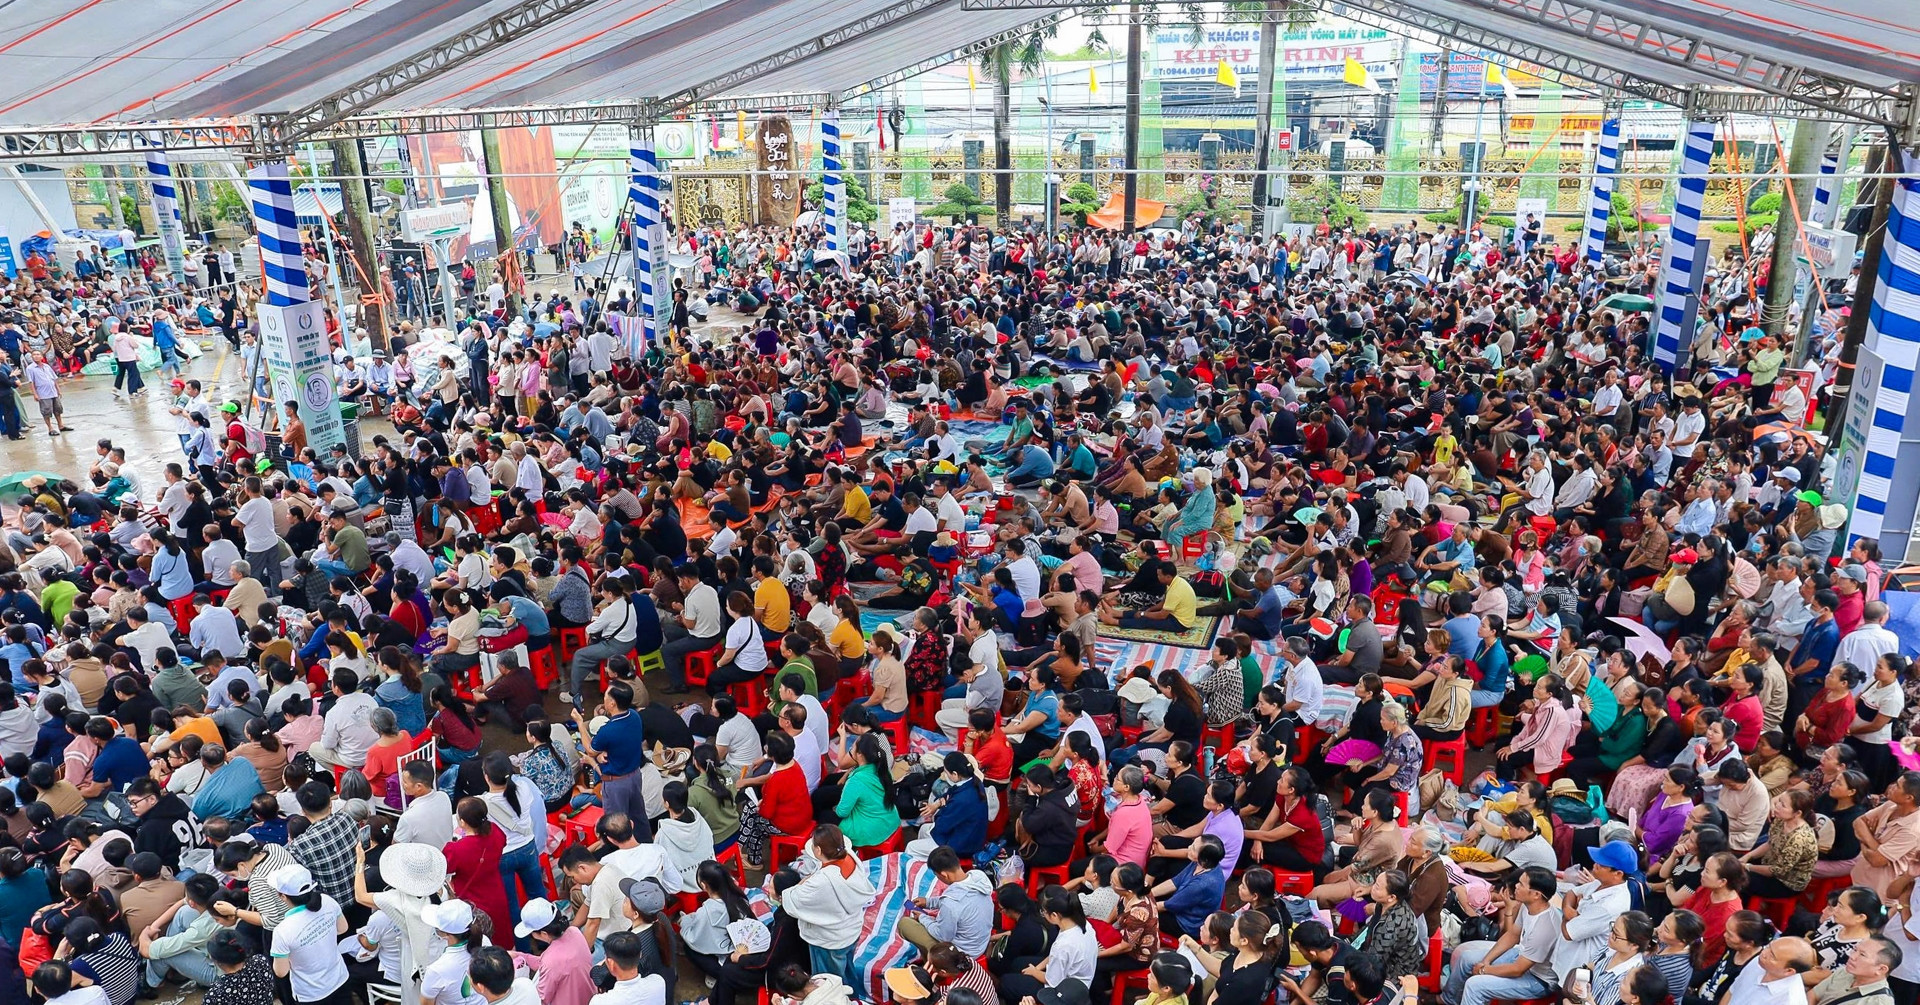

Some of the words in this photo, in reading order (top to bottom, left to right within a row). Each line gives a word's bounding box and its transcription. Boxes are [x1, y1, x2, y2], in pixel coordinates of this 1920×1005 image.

[1208, 28, 1250, 42] KHÁCH
[1338, 26, 1358, 39] MÁY
[1361, 29, 1387, 41] LẠNH
[1284, 46, 1365, 62] RINH
